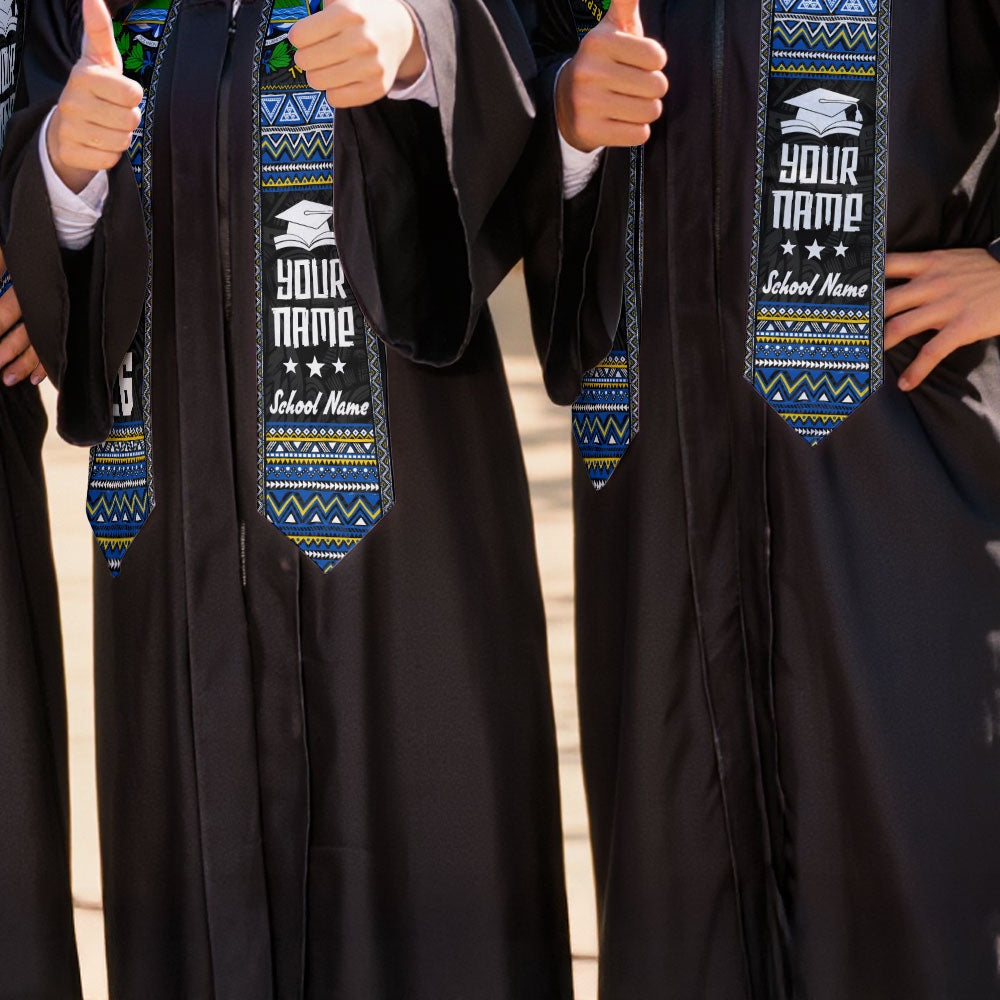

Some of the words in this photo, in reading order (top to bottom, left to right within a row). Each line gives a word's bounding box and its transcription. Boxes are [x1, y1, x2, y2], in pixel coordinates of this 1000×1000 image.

[778, 143, 859, 186] YOUR
[771, 190, 864, 232] NAME
[276, 258, 347, 300] YOUR
[762, 269, 820, 296] School
[818, 272, 868, 298] Name
[271, 306, 355, 349] NAME
[112, 351, 134, 417] 6
[269, 389, 322, 416] School
[322, 390, 370, 416] Name
